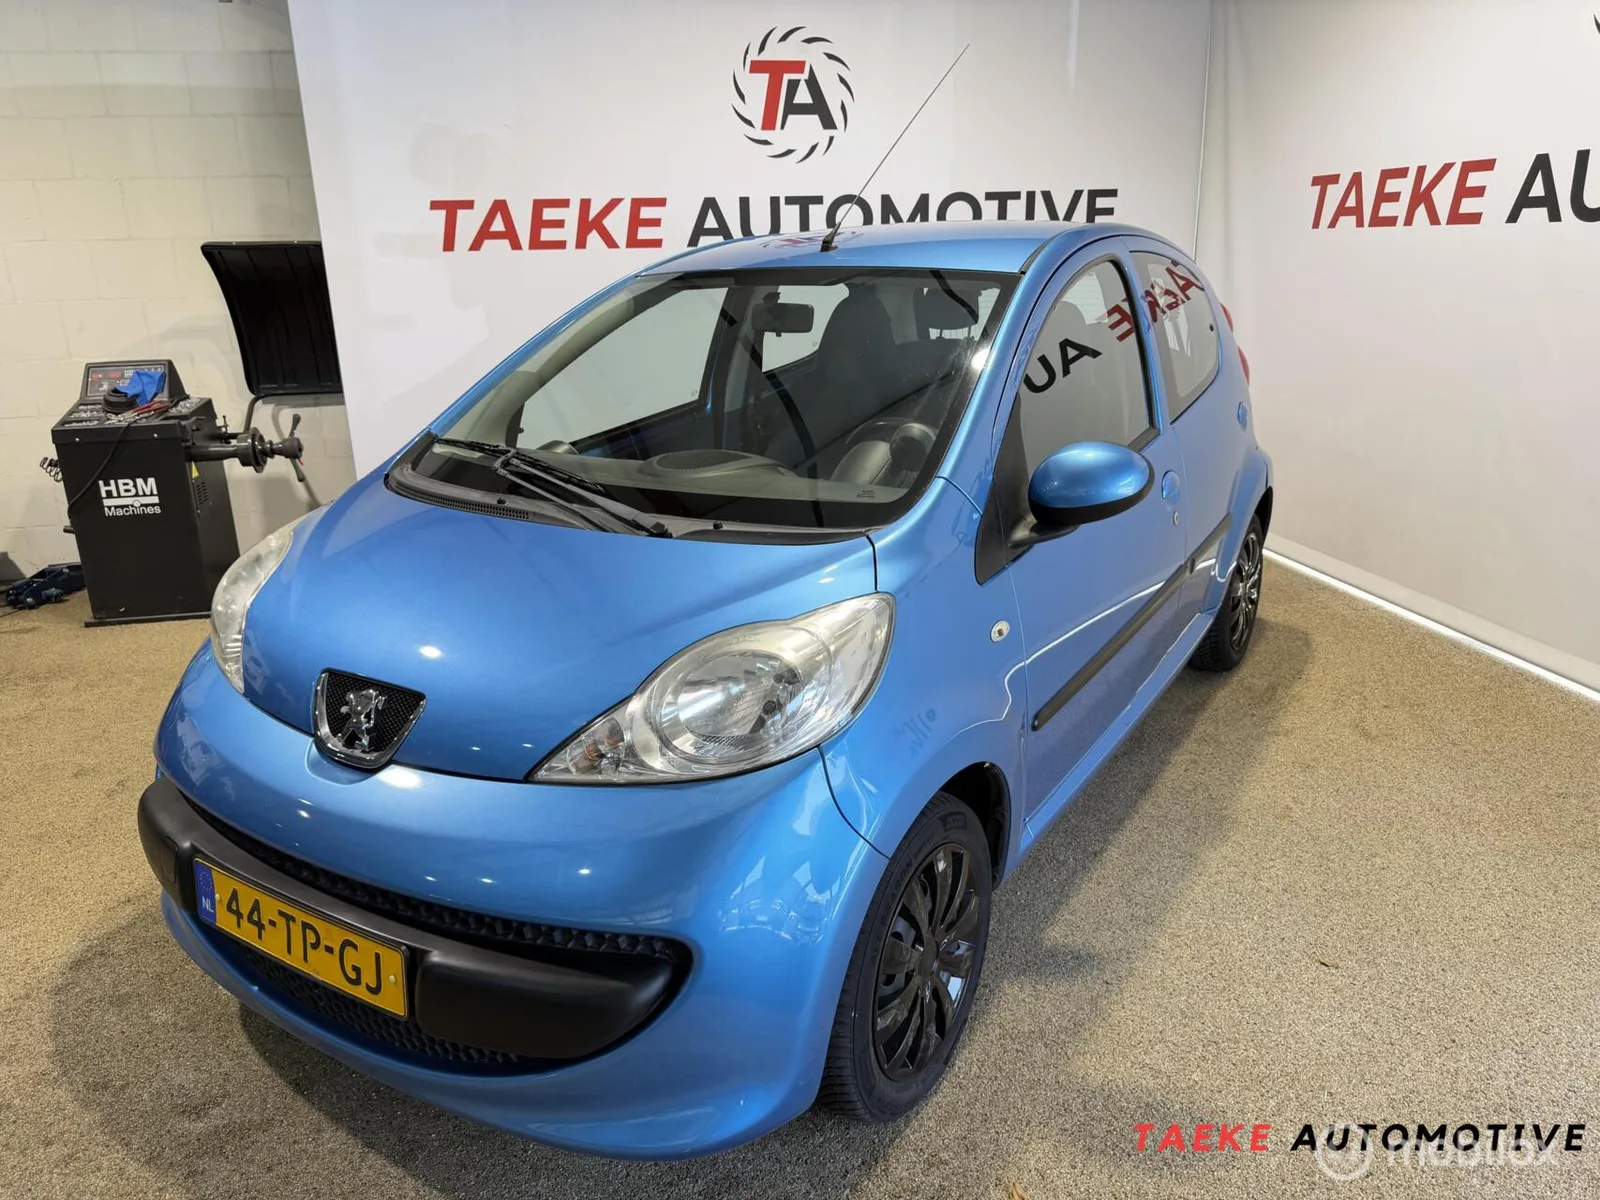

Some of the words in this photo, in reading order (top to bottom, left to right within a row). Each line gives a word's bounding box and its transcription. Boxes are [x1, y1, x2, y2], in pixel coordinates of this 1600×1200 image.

[748, 60, 838, 131] TA
[1310, 158, 1497, 229] TAEKE
[429, 197, 667, 252] TAEKE
[98, 477, 158, 498] HBM
[104, 505, 162, 517] Machines
[202, 896, 214, 914] NL
[226, 887, 383, 996] 44-TP-GJ
